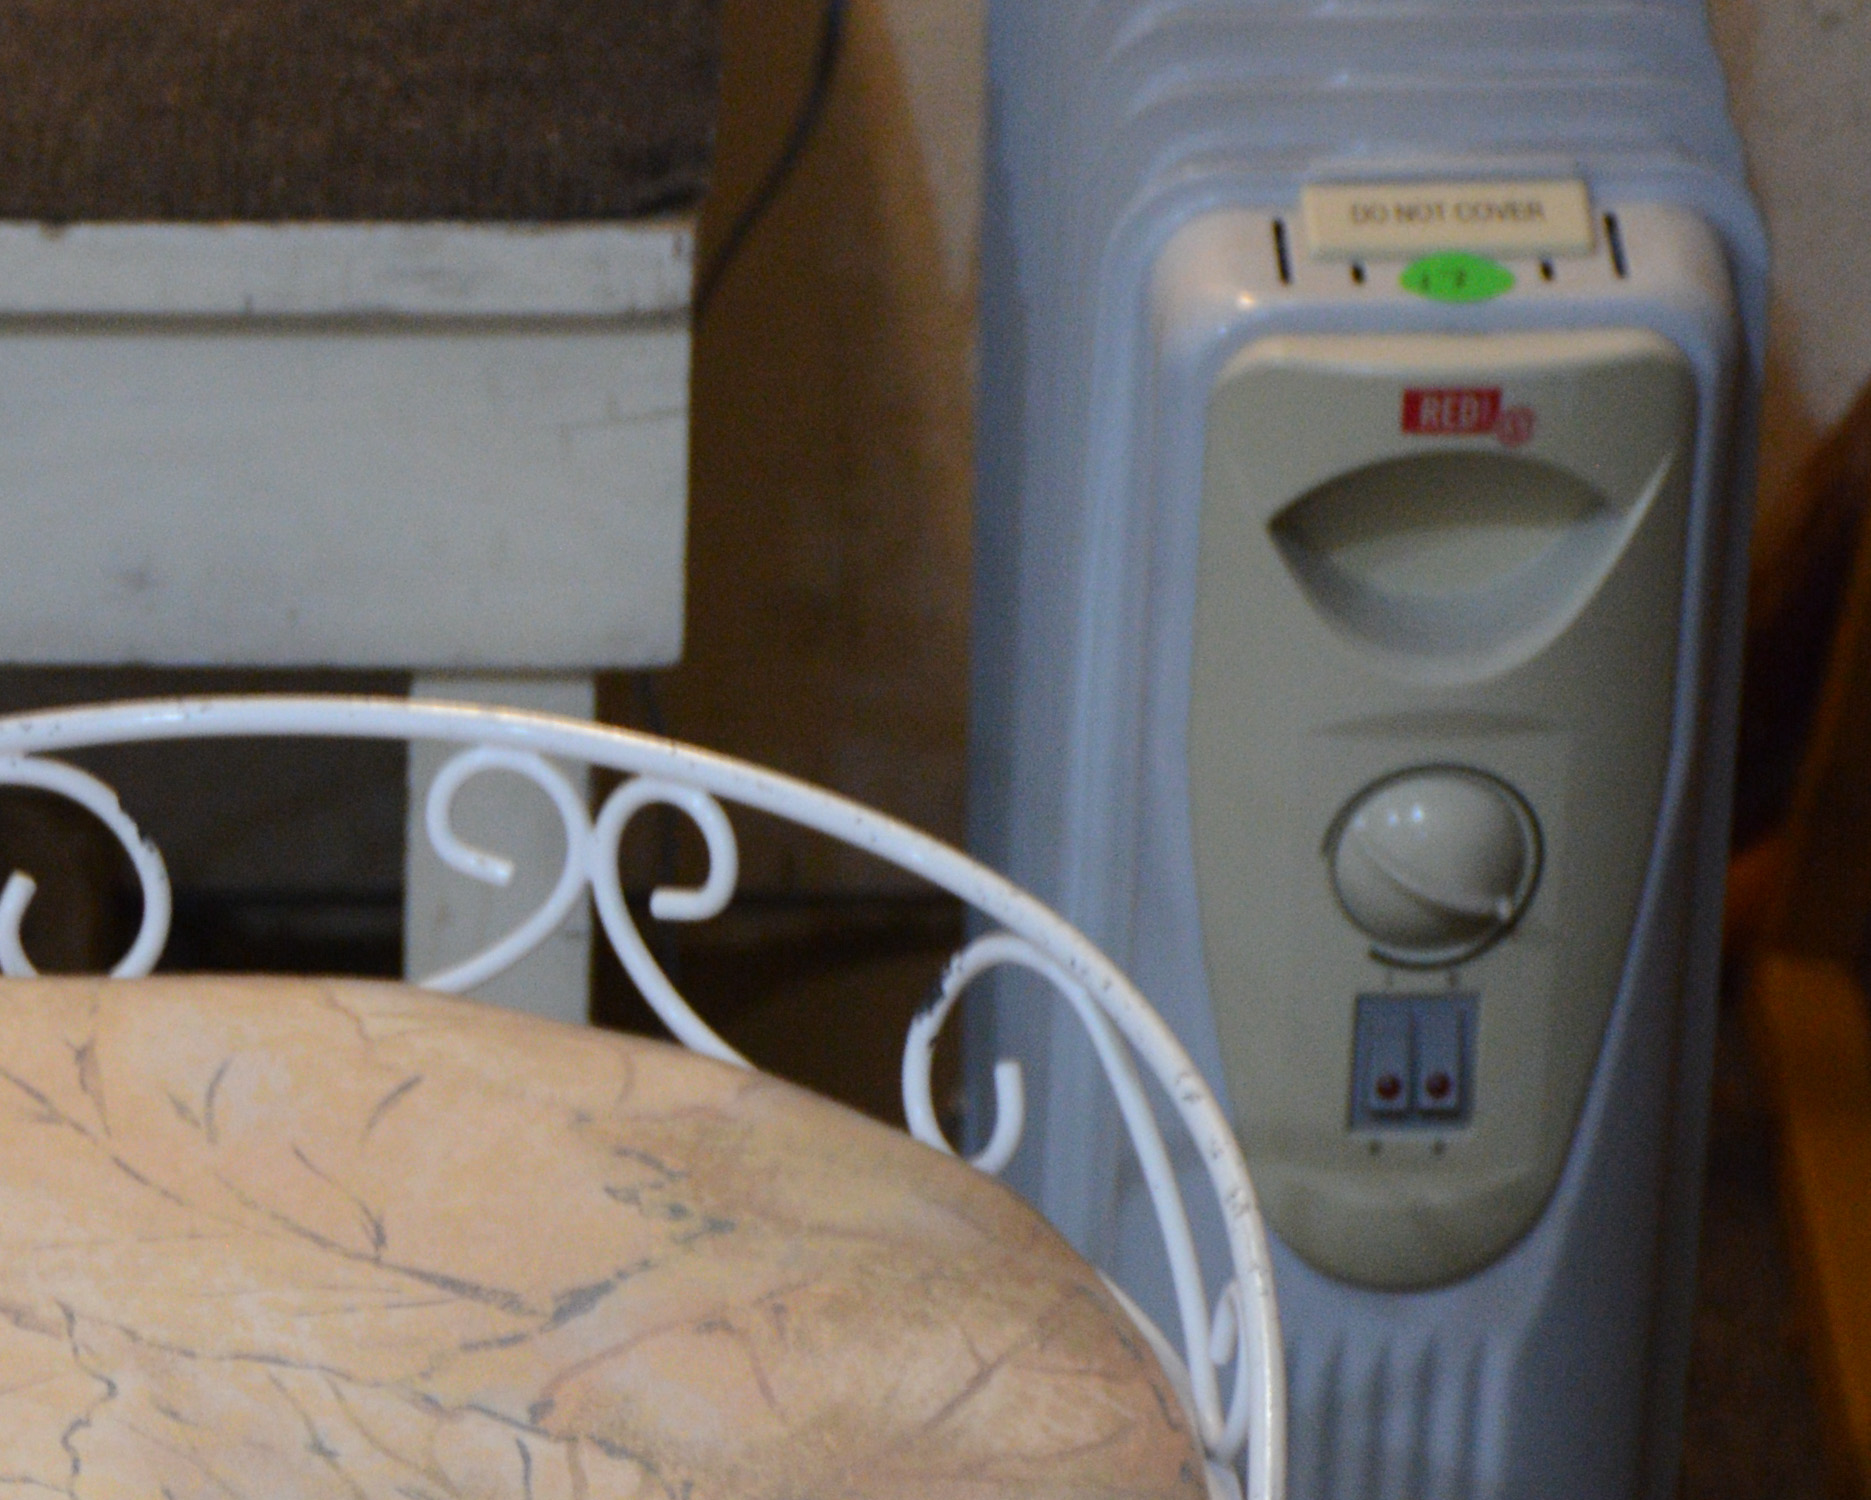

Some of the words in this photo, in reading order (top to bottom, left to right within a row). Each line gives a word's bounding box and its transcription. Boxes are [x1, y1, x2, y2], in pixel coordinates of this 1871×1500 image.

[1349, 203, 1389, 225] DO
[1393, 202, 1446, 224] NOT
[1452, 200, 1546, 222] COVER
